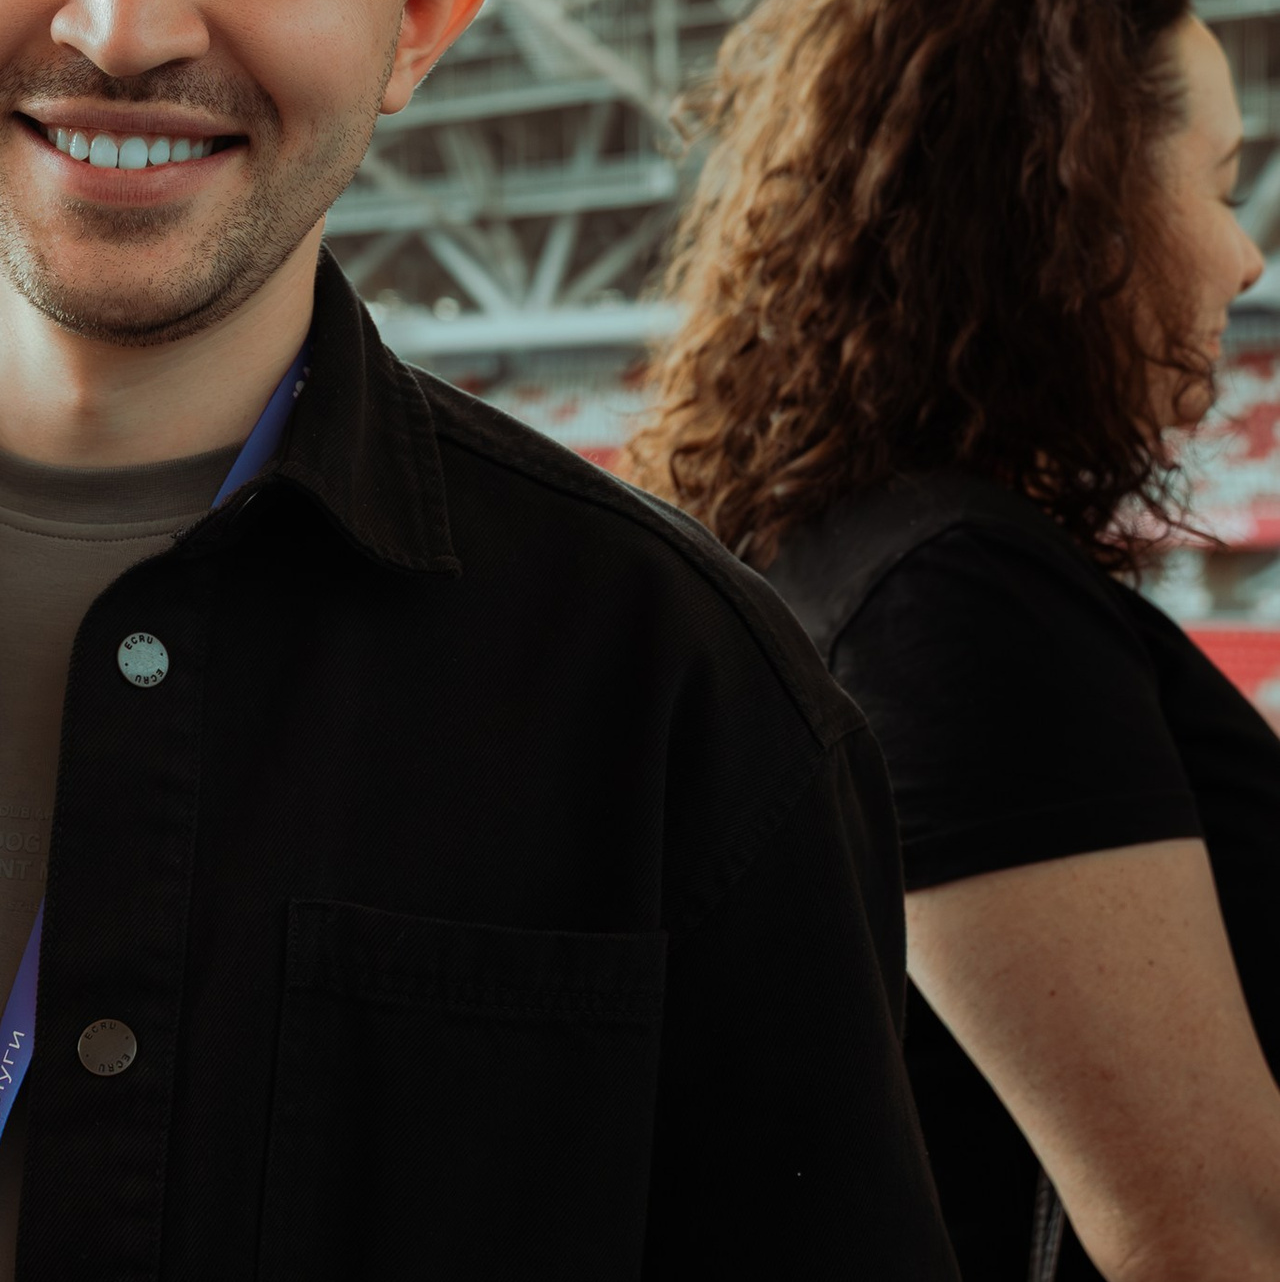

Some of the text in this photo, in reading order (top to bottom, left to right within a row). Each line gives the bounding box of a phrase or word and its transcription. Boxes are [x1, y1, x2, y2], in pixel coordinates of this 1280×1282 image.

[124, 634, 153, 650] ECRU
[135, 668, 164, 685] ECRU
[84, 1021, 117, 1040] ECRU
[98, 1053, 131, 1073] ECRU
